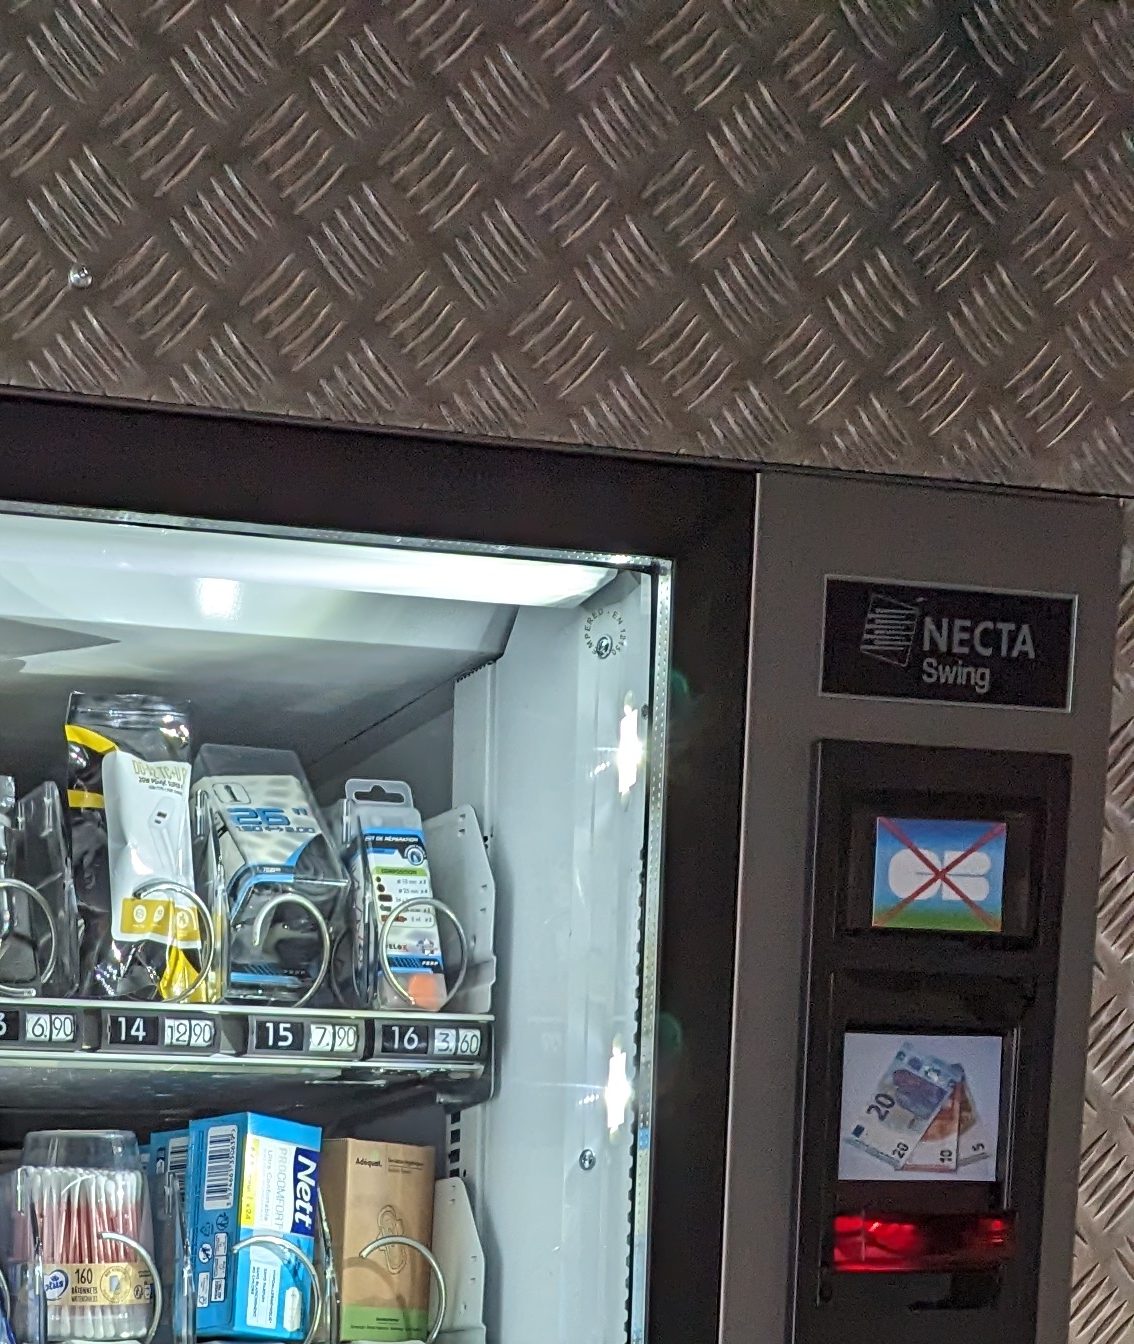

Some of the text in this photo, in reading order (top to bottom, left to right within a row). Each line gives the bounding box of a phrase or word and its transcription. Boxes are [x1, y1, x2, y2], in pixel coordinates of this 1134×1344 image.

[922, 616, 1036, 659] NECTA
[922, 657, 991, 693] Swing
[264, 1023, 293, 1048] 15
[391, 1027, 418, 1049] 16
[294, 1154, 317, 1228] Nett
[74, 1269, 94, 1284] 160
